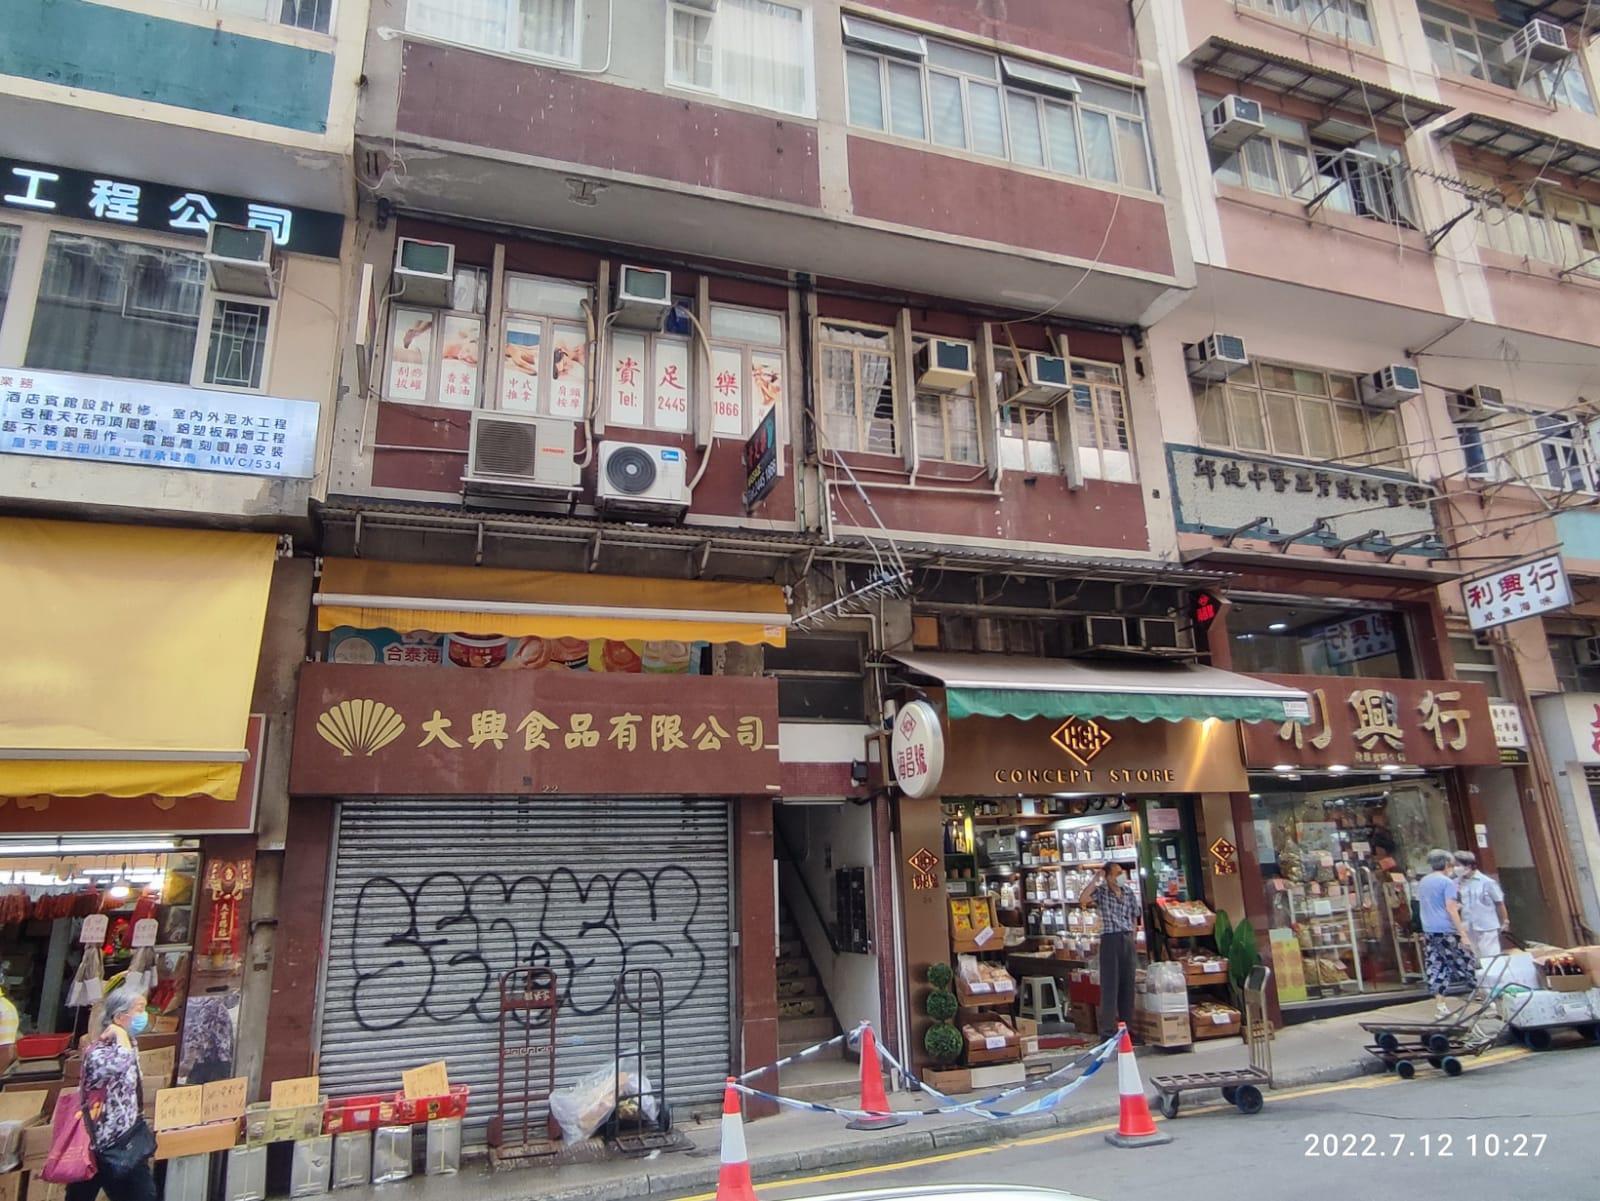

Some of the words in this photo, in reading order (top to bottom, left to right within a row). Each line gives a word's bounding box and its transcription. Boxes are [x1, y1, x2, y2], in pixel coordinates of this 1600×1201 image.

[3, 167, 293, 246] 工程公司
[617, 390, 638, 408] Tel:
[658, 396, 686, 413] 2445
[713, 401, 739, 417] 1866
[209, 456, 282, 471] MWC/534
[1467, 562, 1559, 609] 利興行
[416, 709, 765, 752] 大興食品有限公司
[994, 768, 1095, 784] CONCEPT
[1109, 769, 1175, 784] STORE
